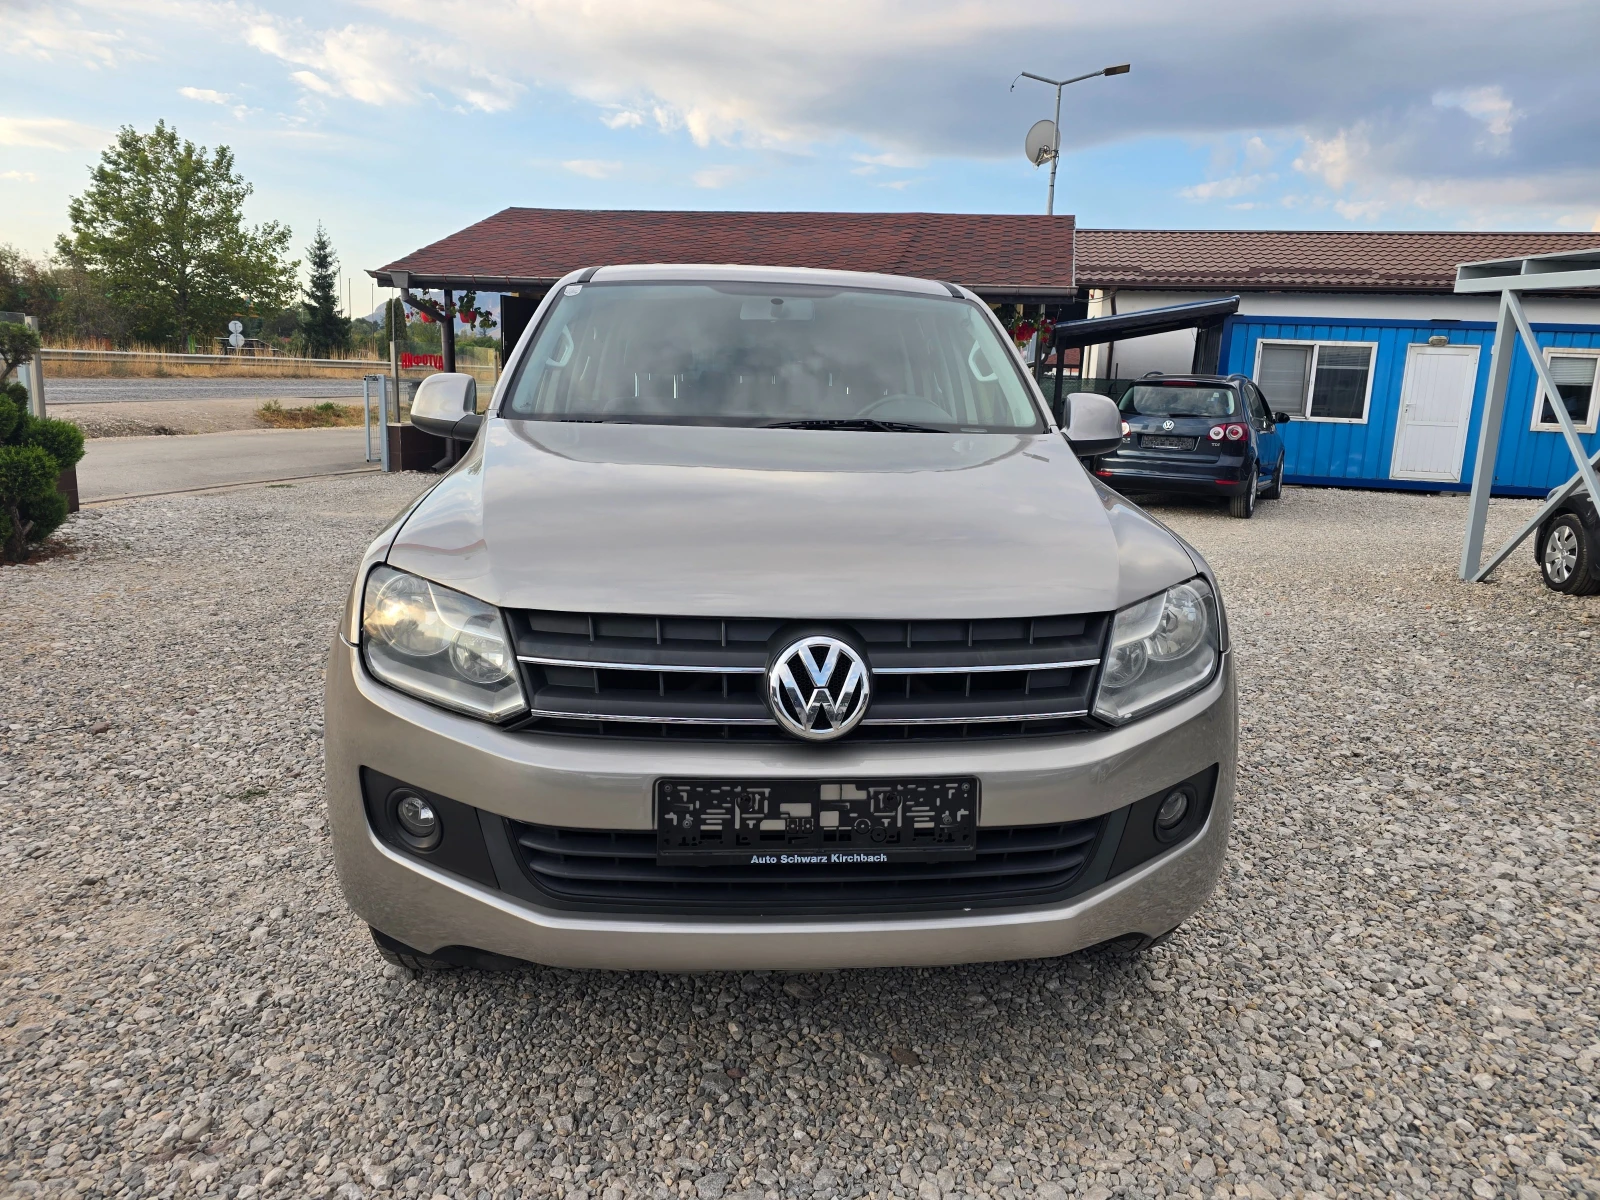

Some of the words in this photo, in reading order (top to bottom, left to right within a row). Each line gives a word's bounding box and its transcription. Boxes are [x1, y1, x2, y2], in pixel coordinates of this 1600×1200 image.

[750, 855, 778, 864] Auto
[780, 854, 828, 864] Schwarz
[831, 853, 888, 863] Kirchbach
